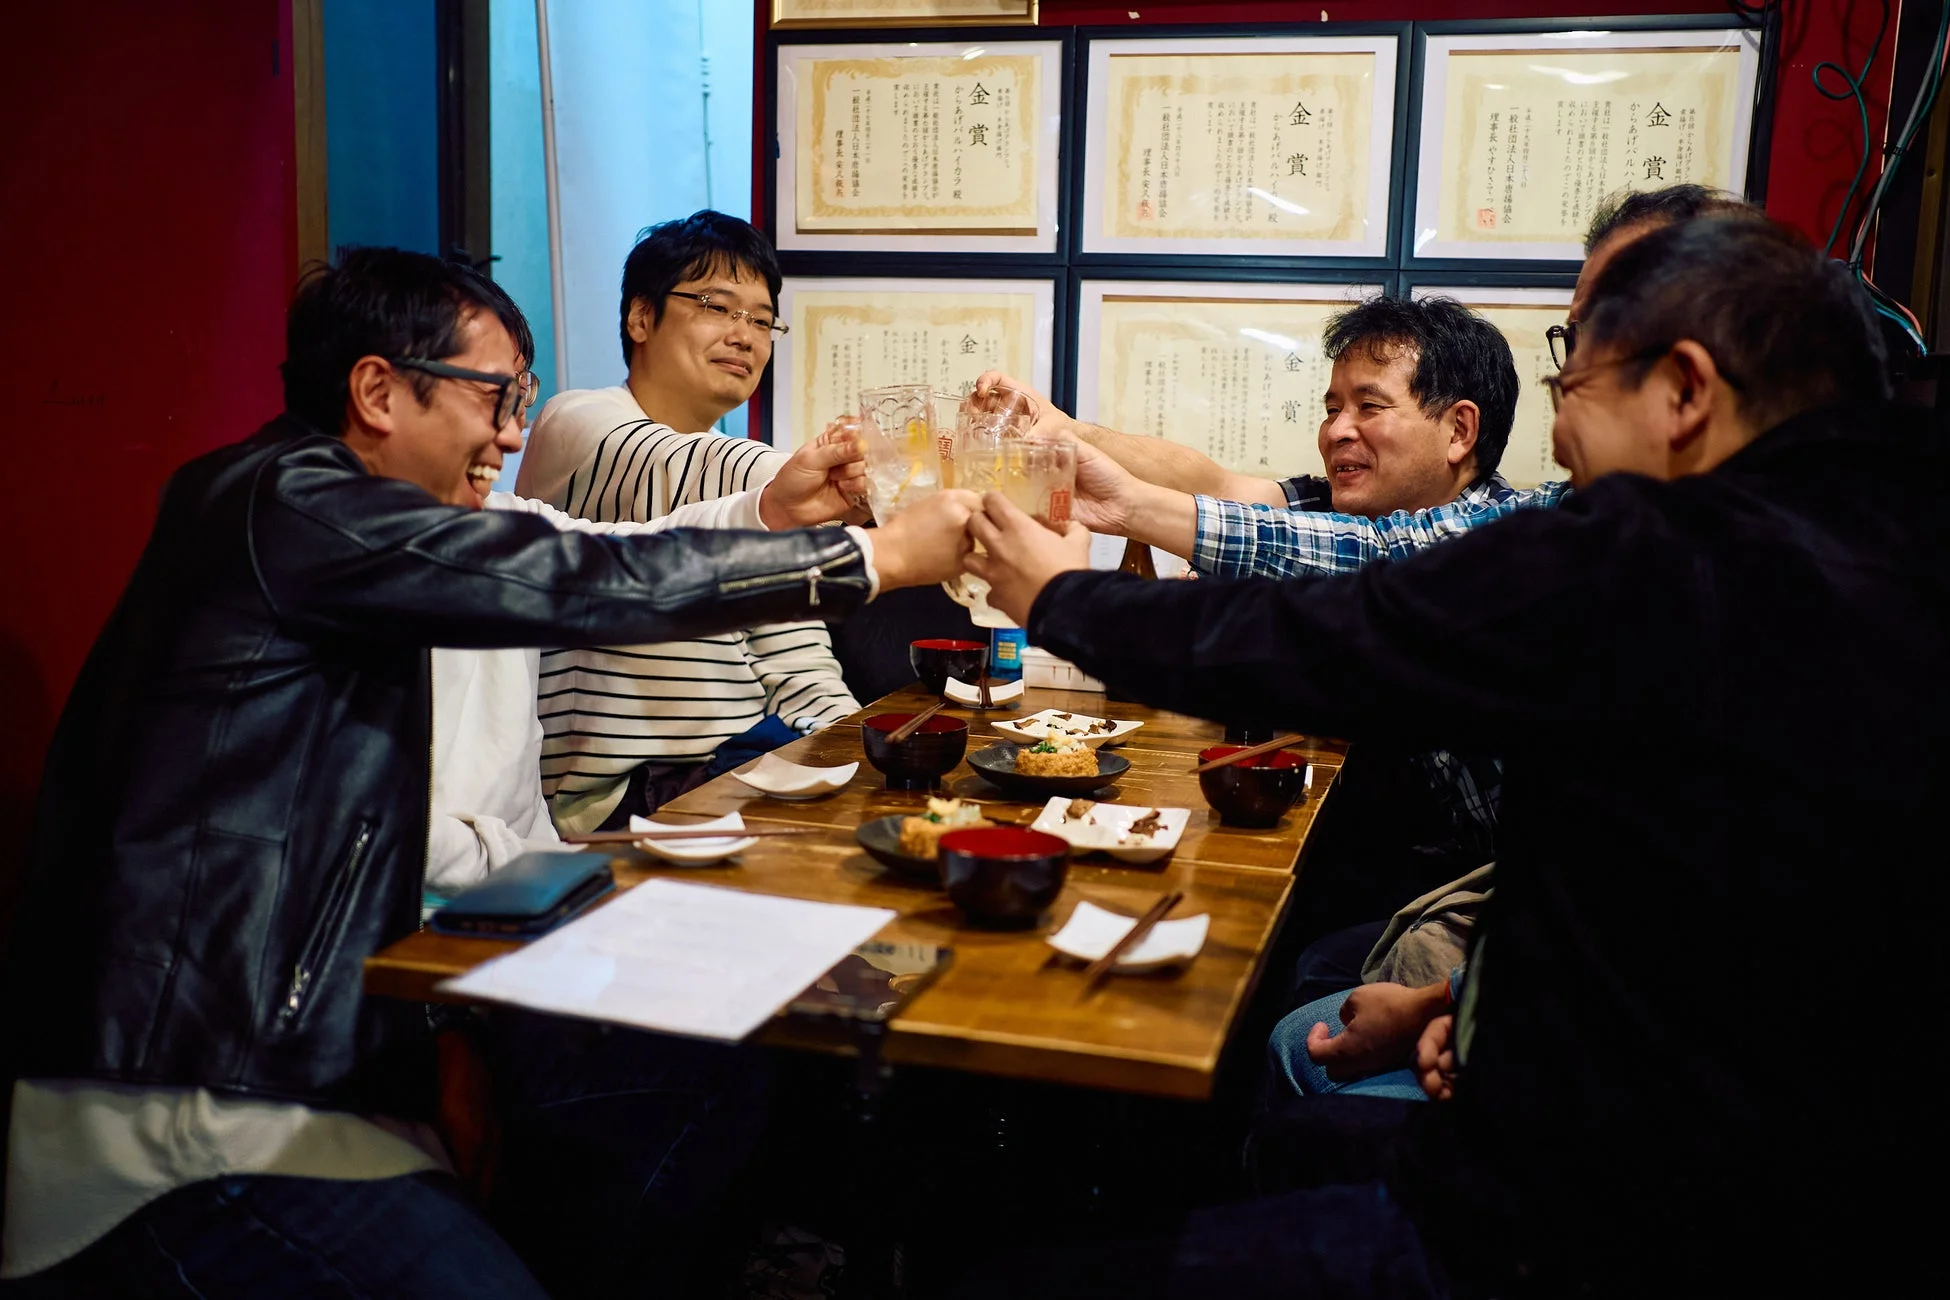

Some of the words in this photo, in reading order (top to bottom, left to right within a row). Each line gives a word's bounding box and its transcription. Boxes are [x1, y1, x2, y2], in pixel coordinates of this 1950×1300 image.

[968, 82, 990, 146] 金賞
[1287, 101, 1312, 177] 金賞
[1642, 102, 1672, 181] 金賞
[1281, 351, 1304, 423] 金賞
